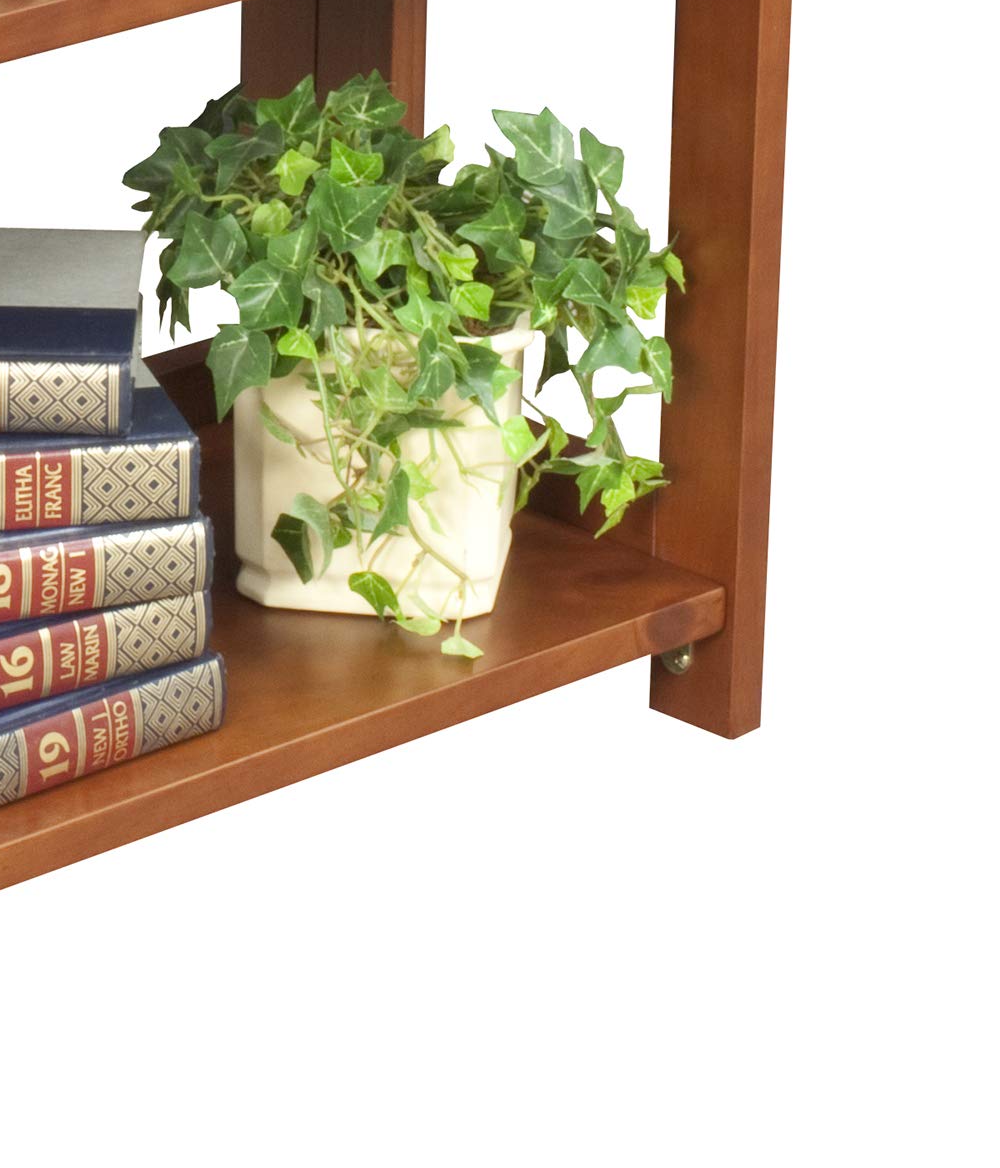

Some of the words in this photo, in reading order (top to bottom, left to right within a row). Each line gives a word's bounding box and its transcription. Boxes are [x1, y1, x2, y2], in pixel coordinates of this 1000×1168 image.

[15, 465, 33, 522] EUTHA
[44, 462, 63, 520] FRANC
[40, 546, 59, 614] MONAG
[68, 568, 87, 606] NEW
[0, 645, 35, 699] 16
[60, 642, 75, 680] LAW
[83, 624, 101, 682] MARIN
[38, 732, 70, 782] 19
[92, 728, 108, 766] NEW
[112, 700, 129, 761] ORTHO
